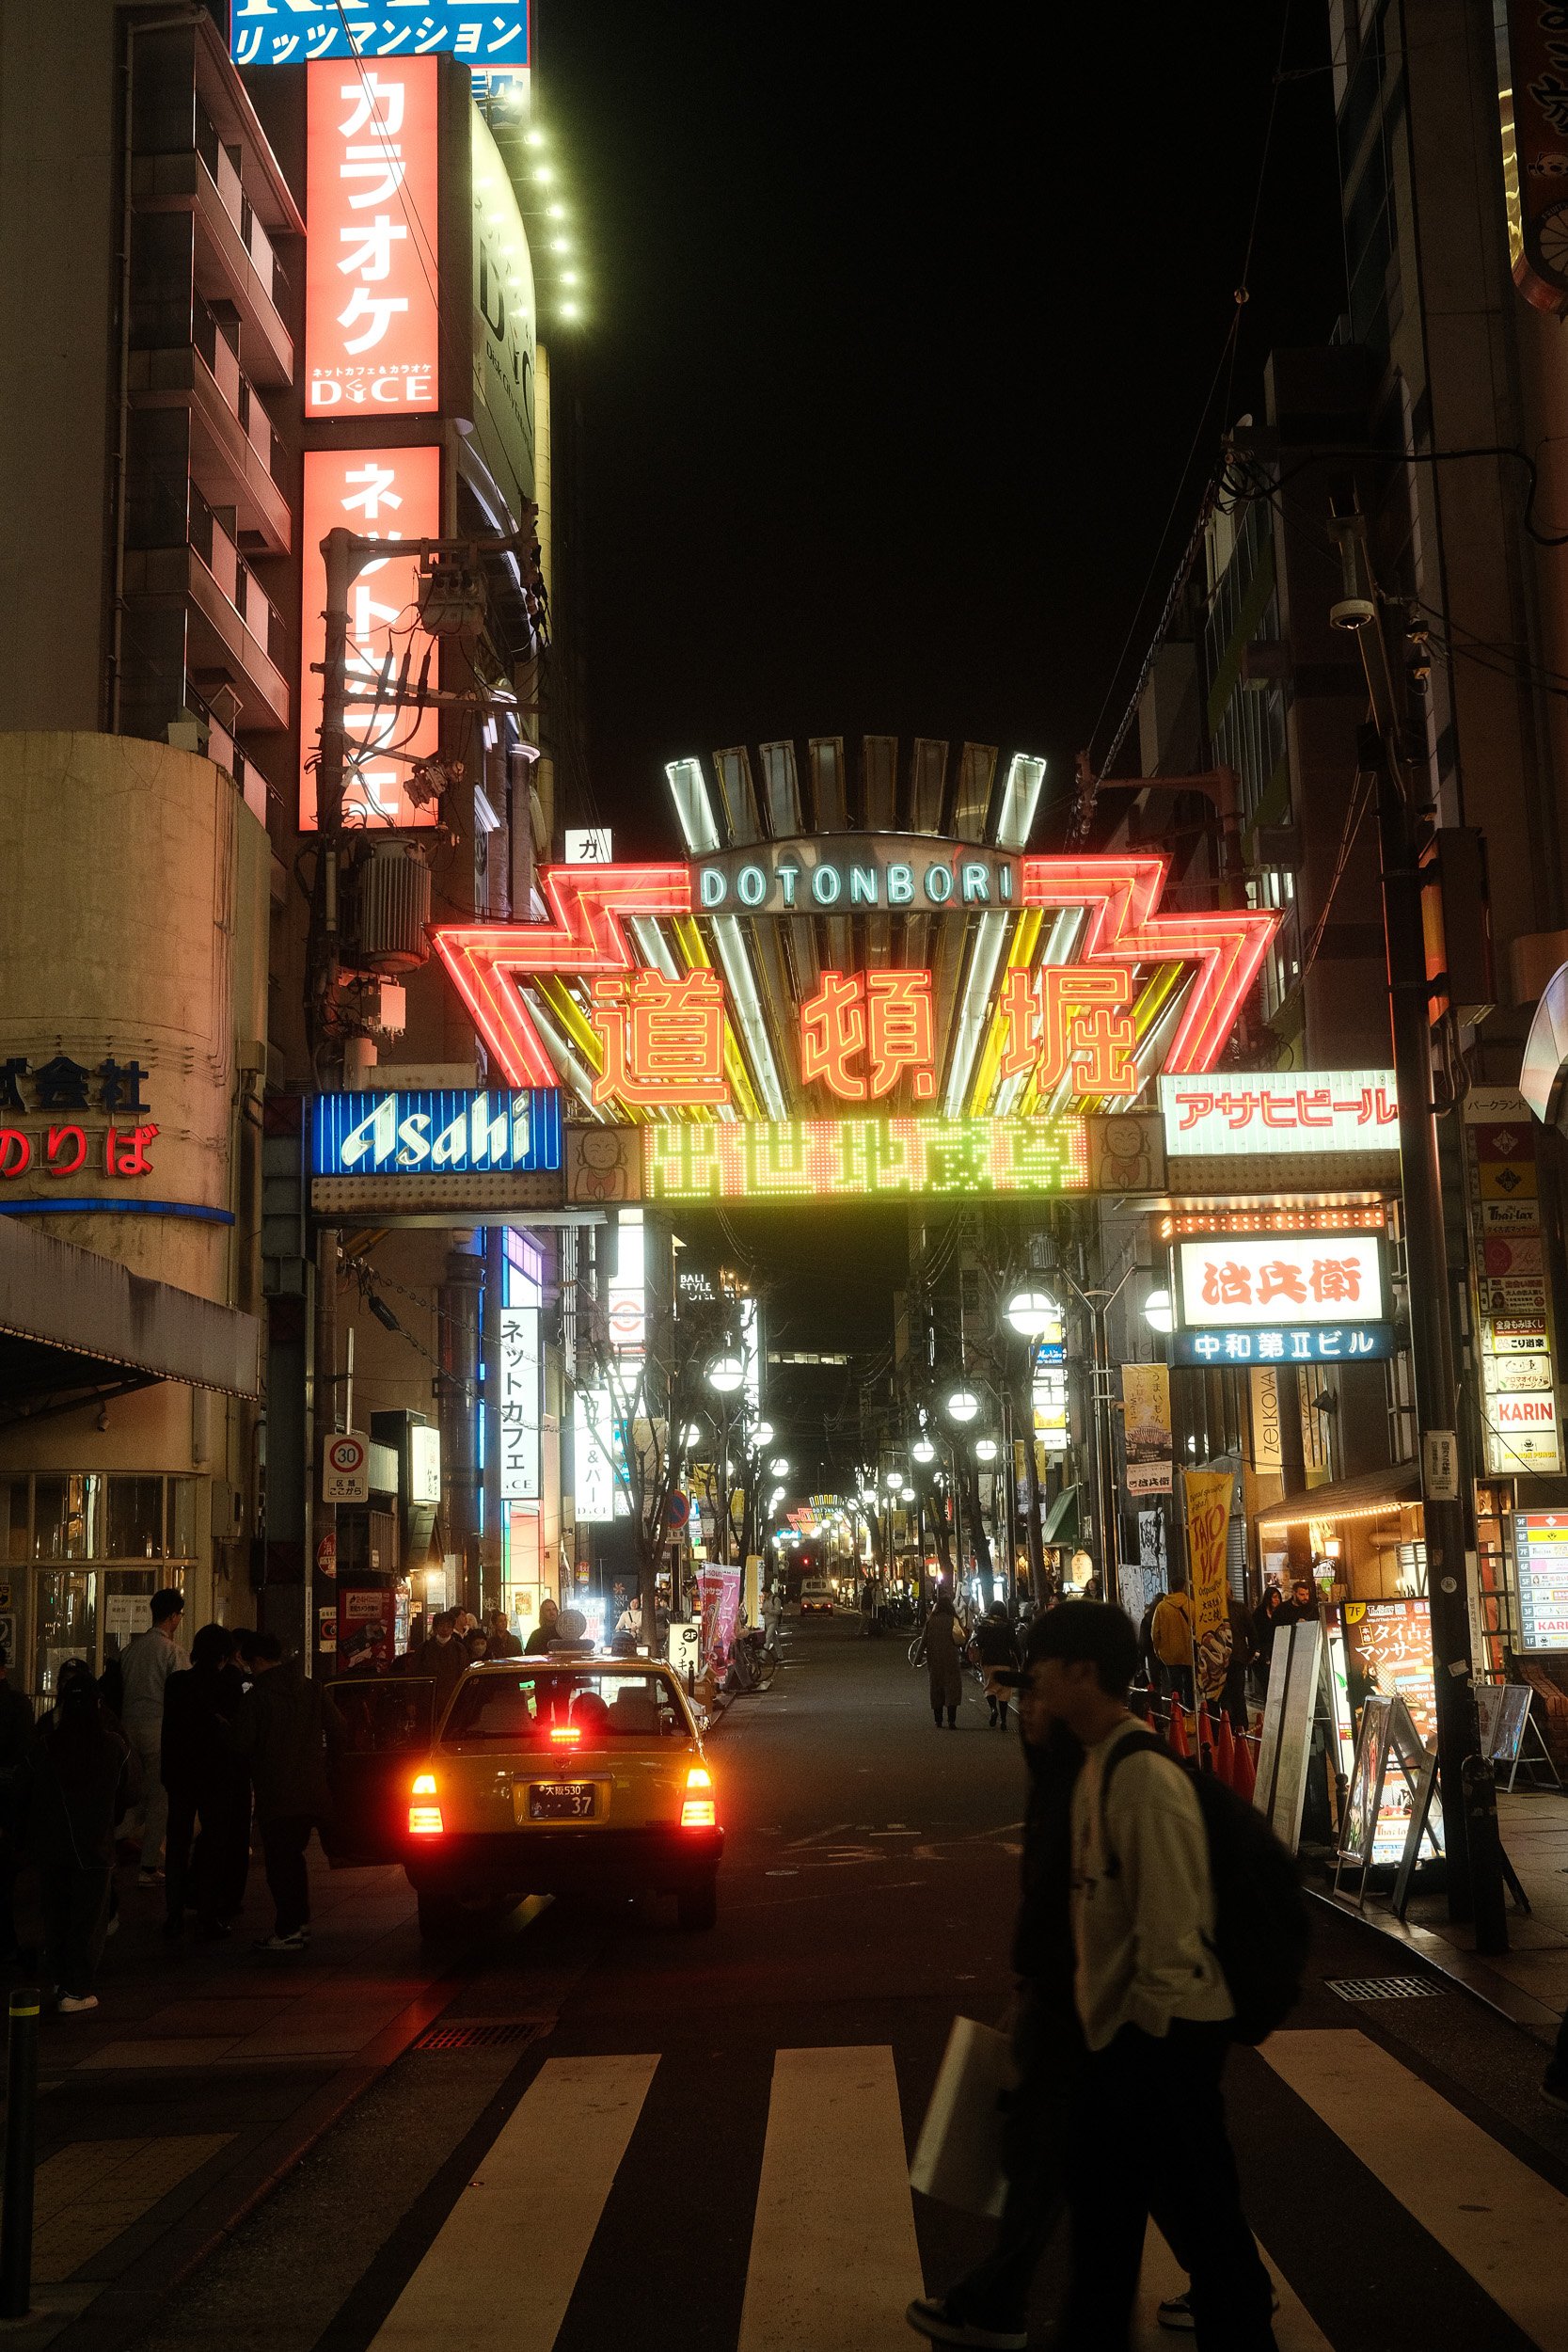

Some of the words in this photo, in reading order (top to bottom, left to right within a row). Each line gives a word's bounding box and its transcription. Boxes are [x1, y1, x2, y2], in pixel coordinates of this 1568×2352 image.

[235, 18, 523, 65] リッツマンション
[336, 72, 409, 357] カラオケ
[700, 862, 1012, 907] DOTONBORI
[591, 963, 1139, 1106] 道頓堀
[1176, 1089, 1398, 1131] アサヒビール
[341, 1090, 530, 1167] Asahi
[679, 1282, 712, 1292] STYLE
[680, 1273, 705, 1283] BALI
[1201, 1258, 1363, 1306] 治兵衛
[1510, 1339, 1545, 1348] こり道楽
[501, 1319, 527, 1470] ネットカフェ
[1498, 1402, 1553, 1422] KARIN
[337, 1448, 356, 1463] 30
[329, 1487, 362, 1496] ここから
[1348, 1606, 1361, 1617] 7F
[684, 1631, 697, 1640] 2F
[571, 1796, 593, 1815] 37
